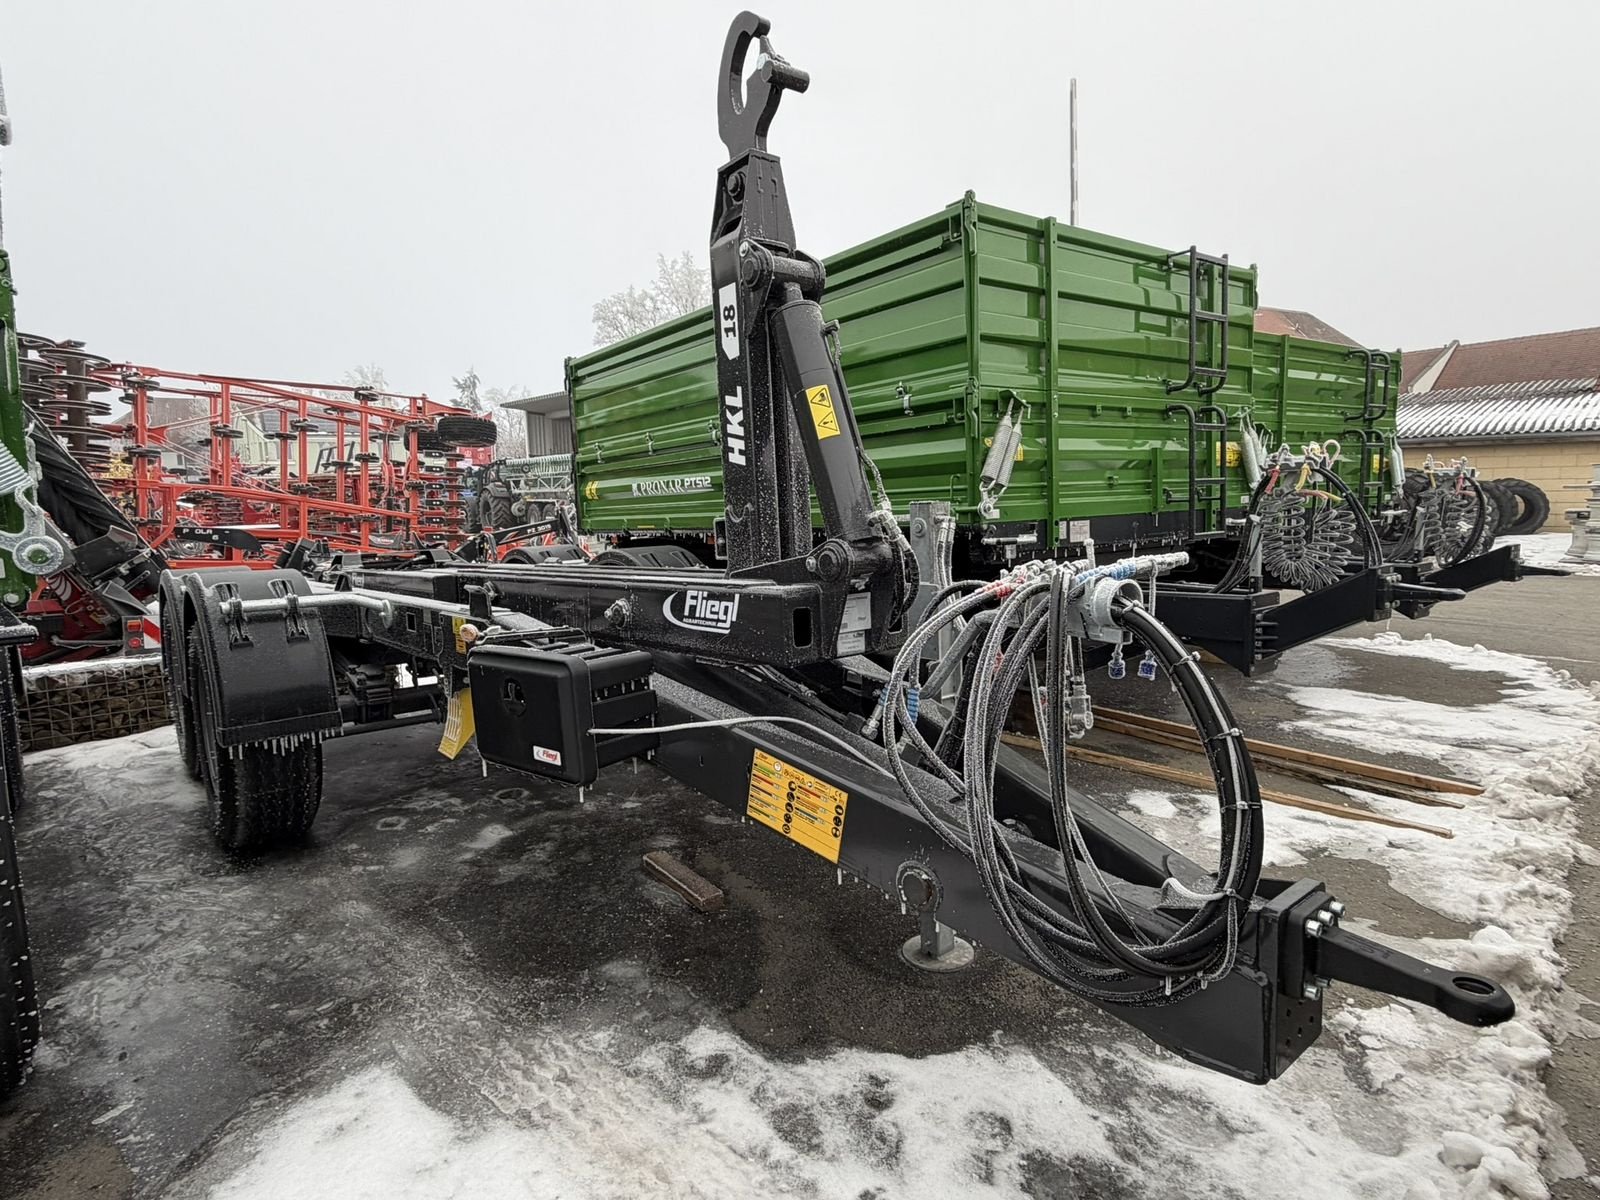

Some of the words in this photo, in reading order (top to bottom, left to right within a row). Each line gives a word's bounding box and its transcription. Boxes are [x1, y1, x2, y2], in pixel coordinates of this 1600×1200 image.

[723, 304, 737, 338] 18
[725, 385, 746, 466] HKL
[640, 478, 685, 496] PRONAR
[683, 590, 740, 628] Fliegl
